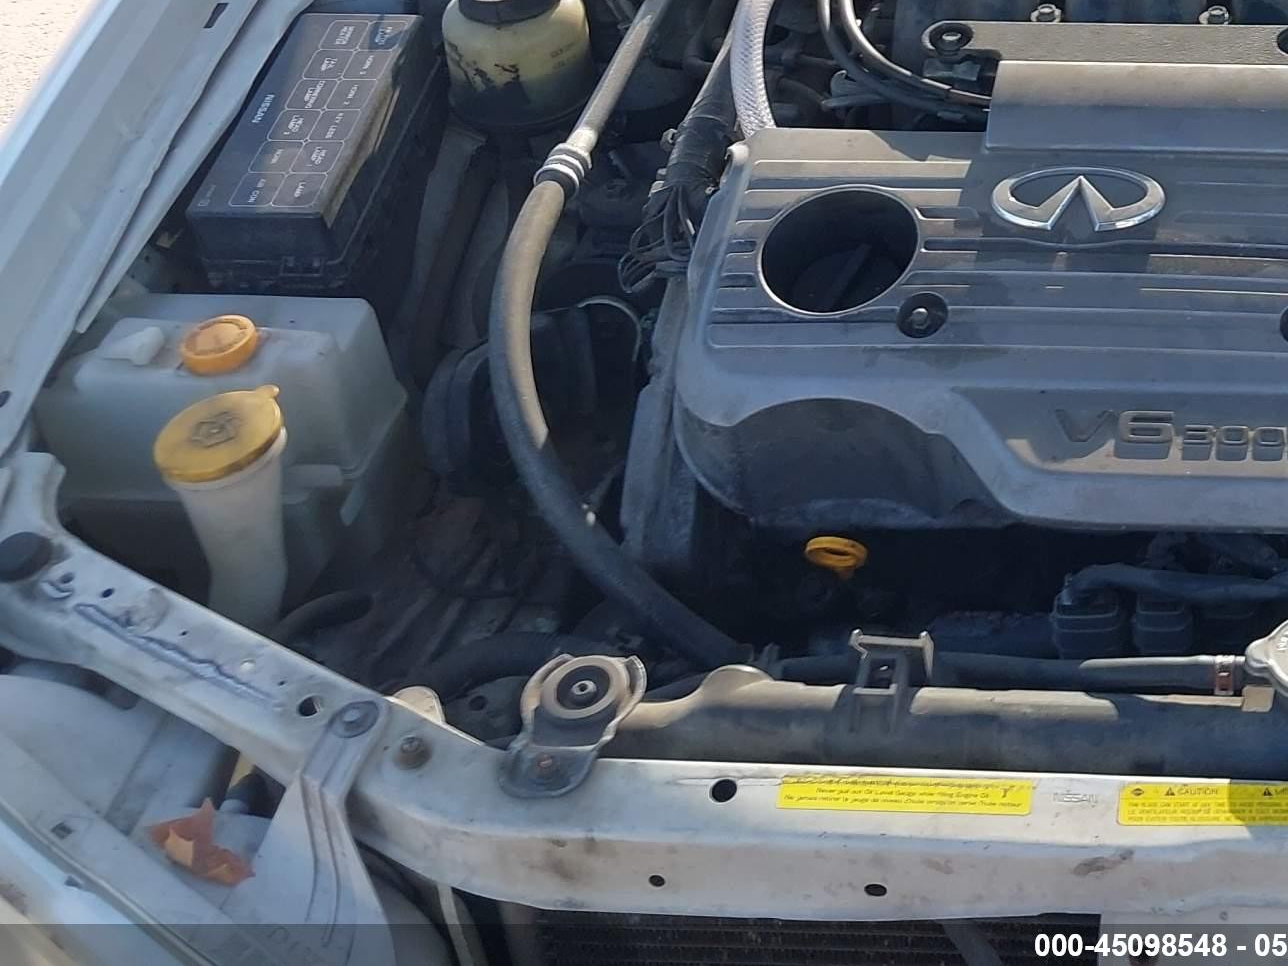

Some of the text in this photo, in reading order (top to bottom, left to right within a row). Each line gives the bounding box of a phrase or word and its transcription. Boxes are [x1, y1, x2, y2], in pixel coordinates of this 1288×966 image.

[252, 94, 276, 123] NISSAN
[248, 190, 260, 202] CON
[294, 181, 307, 198] LAMP
[1177, 786, 1218, 796] CAUTION
